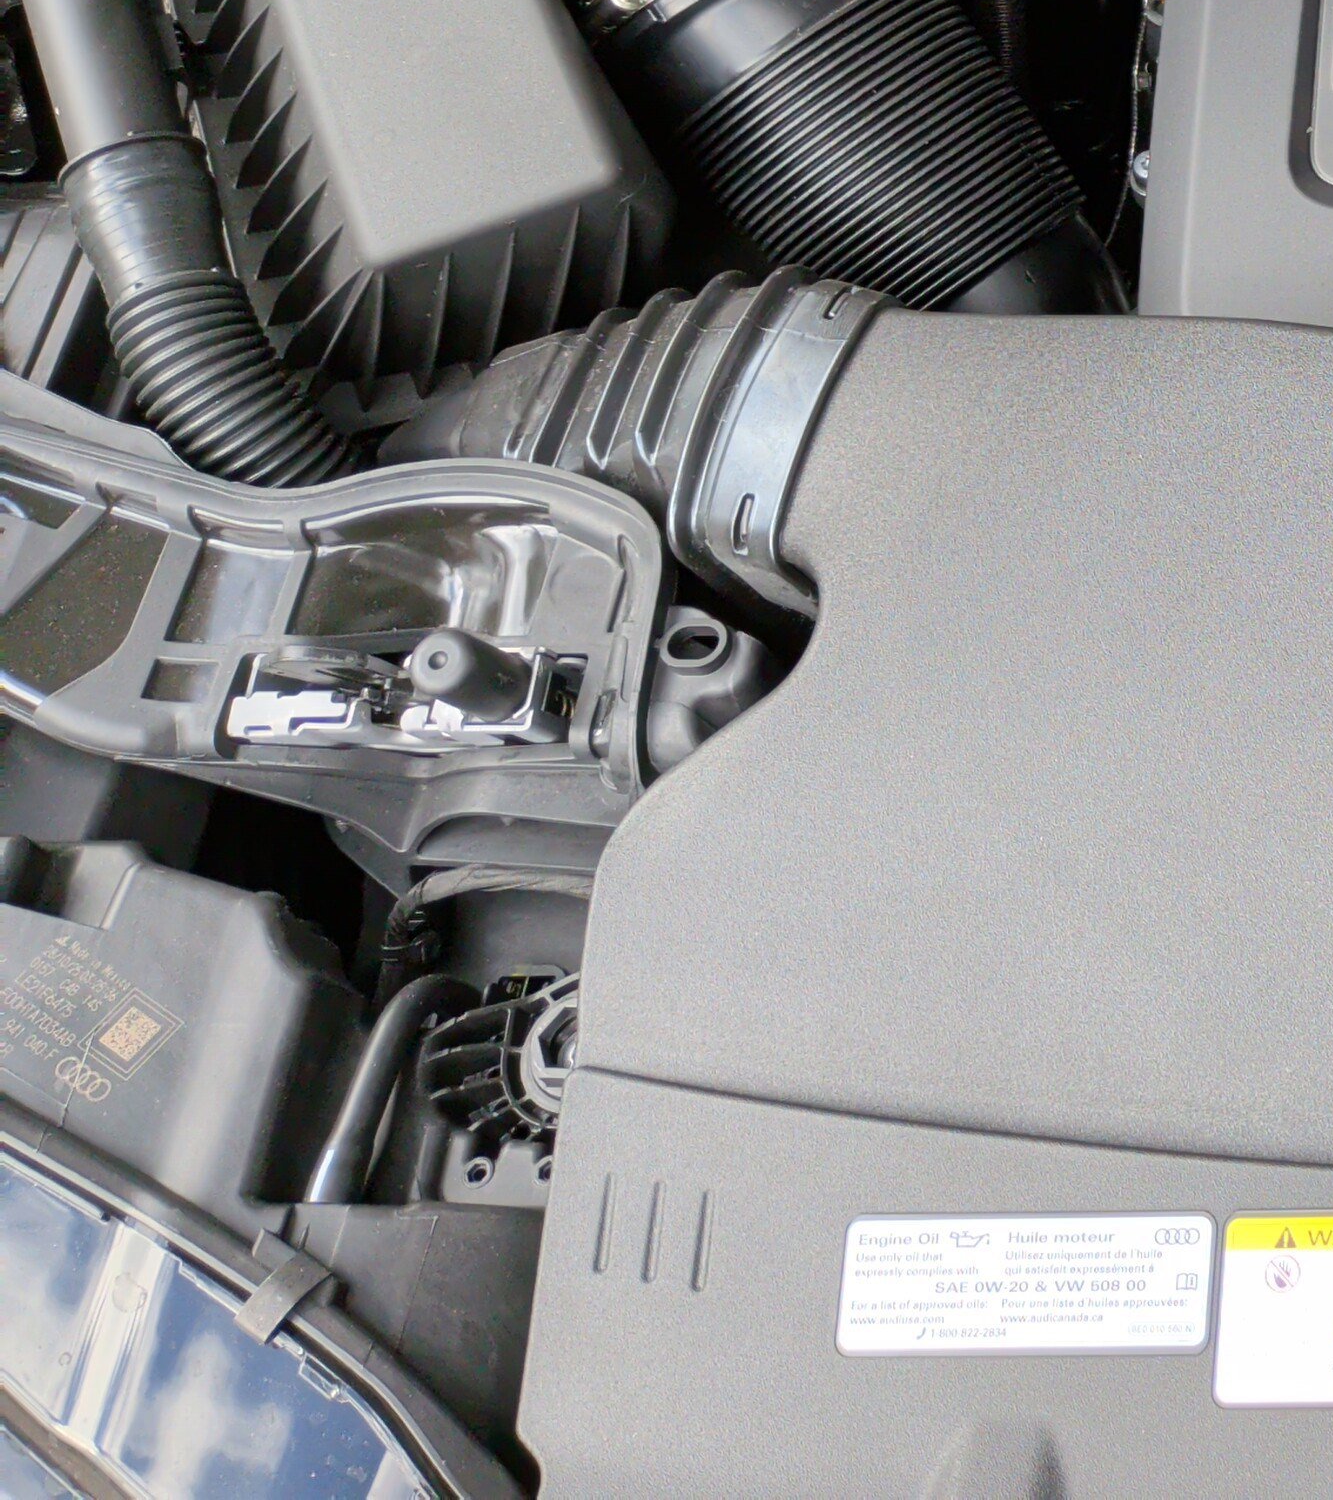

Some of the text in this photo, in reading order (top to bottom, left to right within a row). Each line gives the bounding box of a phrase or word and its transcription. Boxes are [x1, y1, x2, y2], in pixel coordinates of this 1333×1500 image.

[858, 1232, 940, 1249] Engine Oil
[1008, 1231, 1115, 1244] Huile moteur
[856, 1251, 943, 1264] Use only oil that
[1005, 1249, 1044, 1261] Utilisez
[1047, 1249, 1111, 1262] uniquement
[1114, 1249, 1127, 1260] de
[855, 1265, 979, 1278] expressly complies with
[1004, 1264, 1021, 1276] qui
[1025, 1264, 1067, 1275] satisfait
[935, 1279, 1146, 1293] SAE 0W-20 & VW 508 00
[851, 1300, 869, 1310] For
[871, 1302, 877, 1310] a
[880, 1299, 896, 1310] list
[899, 1299, 910, 1310] of
[913, 1299, 963, 1312] approved
[1001, 1298, 1026, 1309] Pour
[1029, 1300, 1049, 1308] une
[1052, 1297, 1075, 1308] liste
[849, 1314, 945, 1326] www.audiusa.com
[1000, 1312, 1103, 1323] www.audicanada.ca
